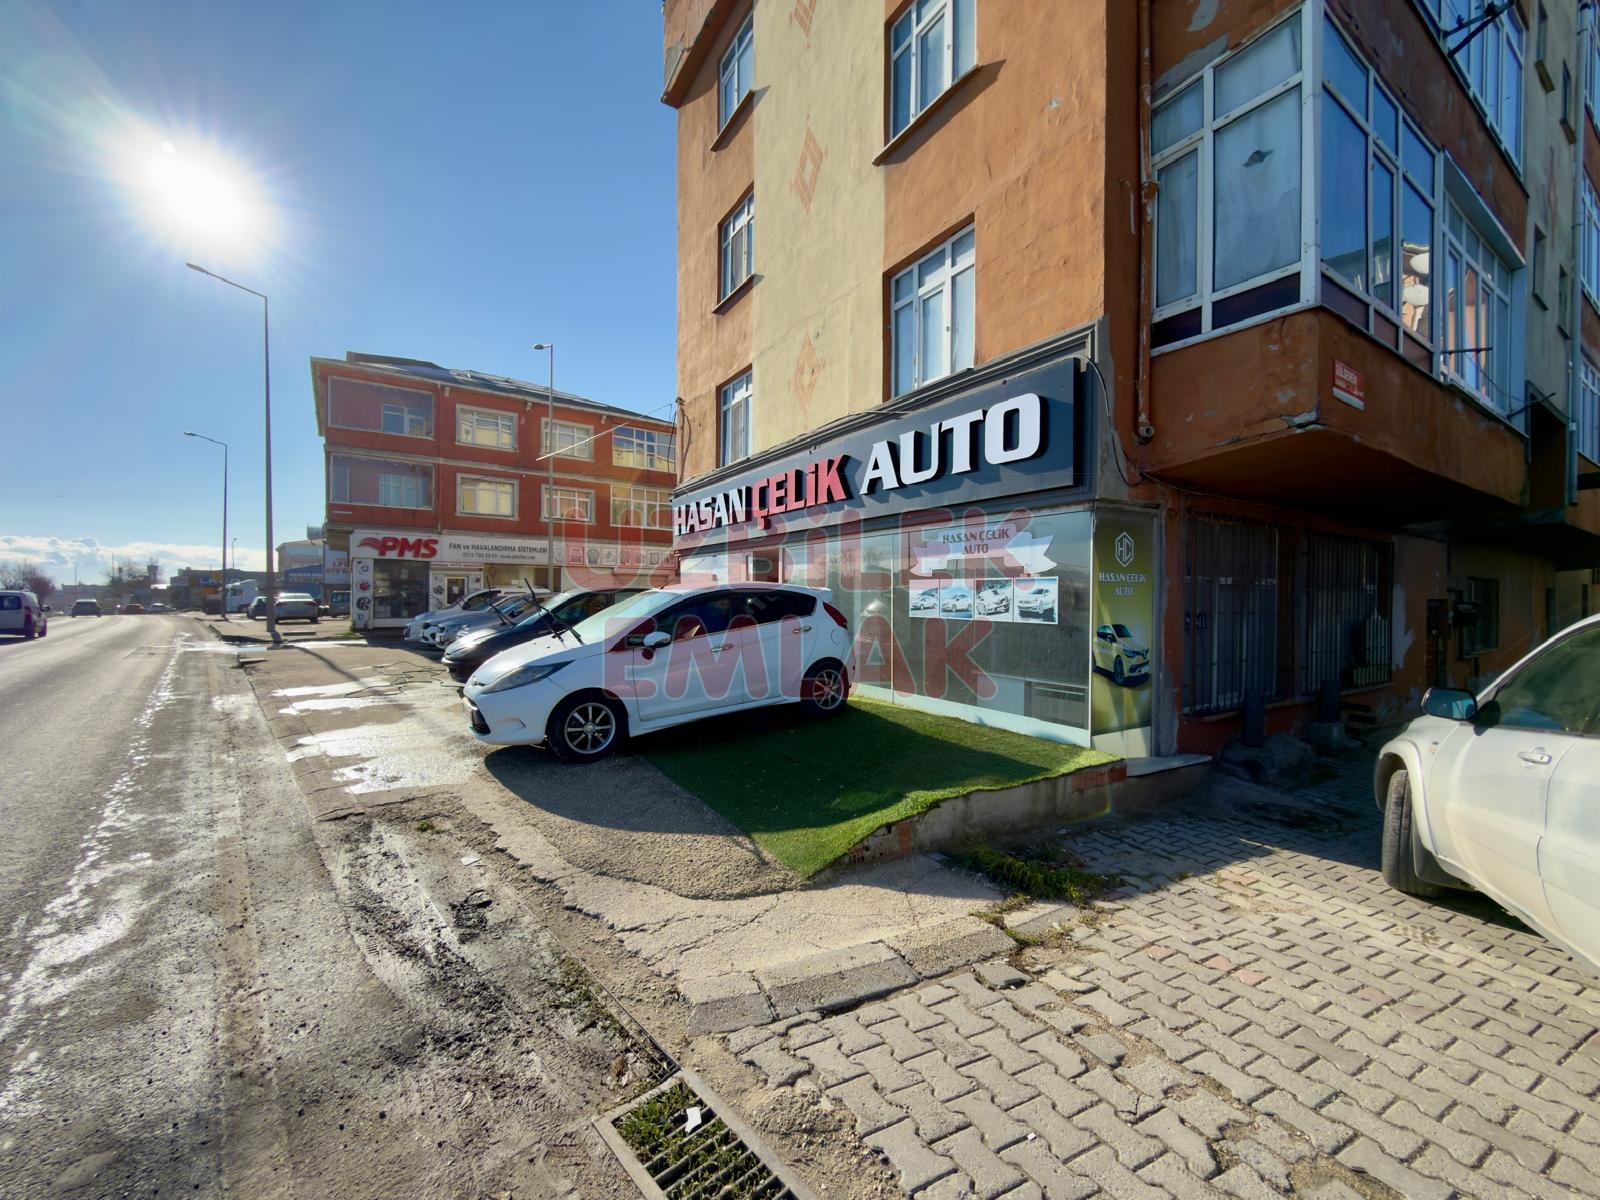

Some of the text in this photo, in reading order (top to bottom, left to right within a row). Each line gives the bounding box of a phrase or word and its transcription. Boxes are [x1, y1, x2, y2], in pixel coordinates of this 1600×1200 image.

[673, 485, 746, 536] HASAN
[859, 392, 1041, 495] AUTO
[942, 529, 978, 544] HASAN
[378, 536, 439, 558] PMS
[471, 544, 516, 552] HAVALANDIRMA
[962, 543, 989, 554] AUTO
[1099, 572, 1126, 582] HASAN
[1113, 586, 1134, 596] AUTO
